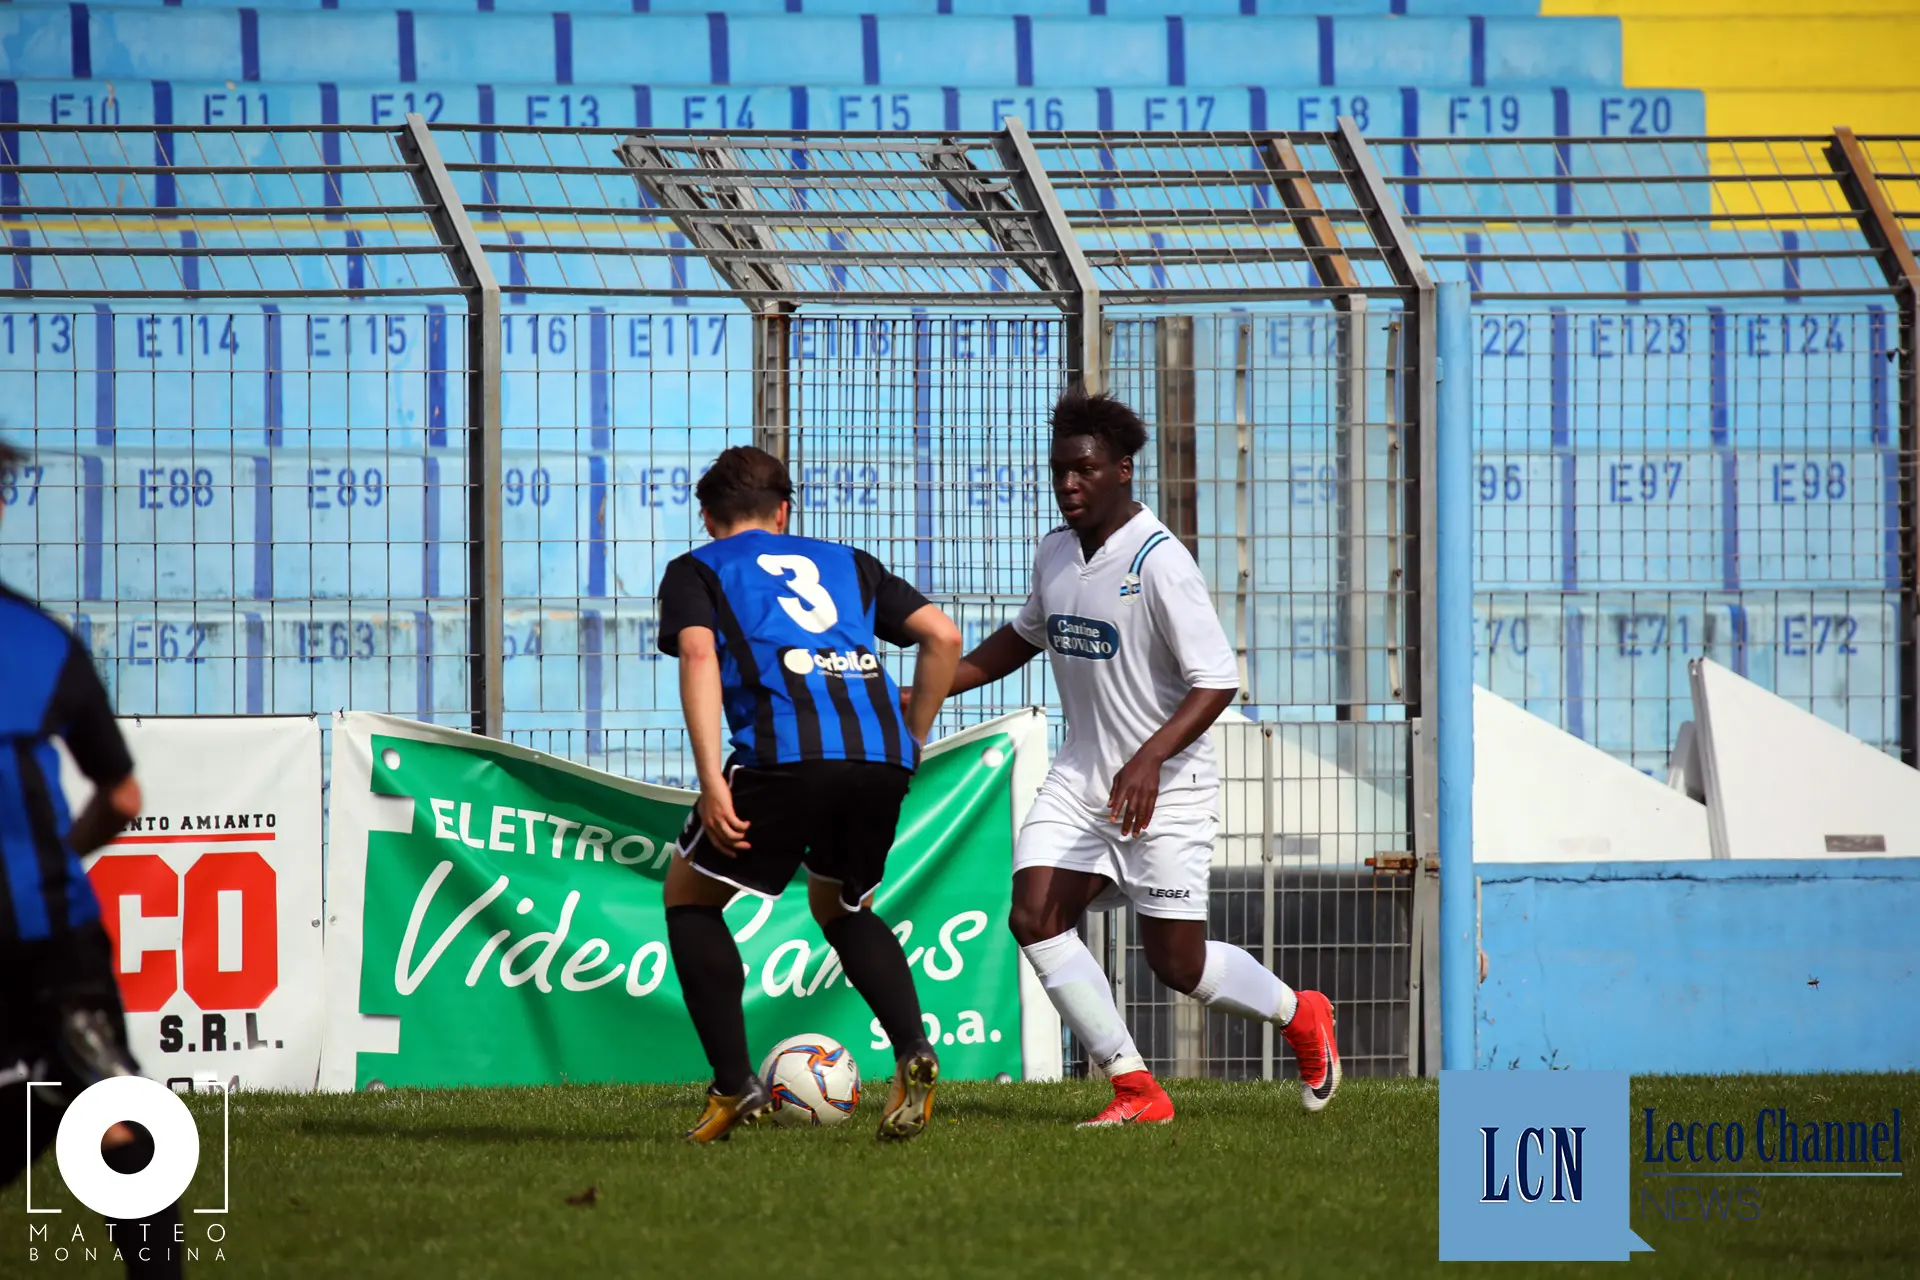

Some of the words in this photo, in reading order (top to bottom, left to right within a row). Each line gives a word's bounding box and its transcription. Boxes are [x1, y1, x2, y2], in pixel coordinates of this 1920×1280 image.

[205, 93, 268, 125] F11
[371, 92, 444, 124] F12
[527, 94, 599, 127] F13
[684, 95, 755, 129] F14
[839, 94, 911, 131] F15
[993, 97, 1064, 131] F16
[1145, 96, 1216, 131] F17
[1297, 95, 1370, 132] F18
[1449, 95, 1520, 134] F19
[1601, 95, 1672, 135] F20
[2, 314, 71, 355] 113
[137, 315, 240, 358] E114
[307, 315, 407, 358] E115
[502, 315, 567, 355] 116
[629, 316, 726, 359] E117
[1483, 317, 1526, 357] 22
[1590, 317, 1688, 358] E123
[1747, 316, 1845, 357] E124
[1, 465, 44, 506] 87
[139, 468, 215, 509] E88
[307, 467, 384, 509] E89
[505, 467, 551, 507] 90
[641, 466, 707, 508] E9
[1291, 464, 1337, 505] E9
[1479, 463, 1522, 502] 96
[1610, 462, 1684, 504] E97
[1773, 461, 1847, 504] E98
[757, 554, 838, 634] 3
[128, 622, 207, 666] E62
[299, 621, 376, 664] E63
[502, 621, 542, 661] 64
[1053, 635, 1112, 654] PROVINO
[1057, 620, 1100, 638] Cantine
[1474, 617, 1530, 656] 70
[1620, 616, 1689, 657] E71
[1783, 615, 1858, 656] E72
[121, 815, 170, 832] NTO
[180, 813, 276, 831] AMIANTO
[1149, 887, 1191, 899] LEGEA
[86, 851, 279, 1013] CO
[394, 860, 668, 997] Video
[160, 1012, 283, 1053] S.R.L.
